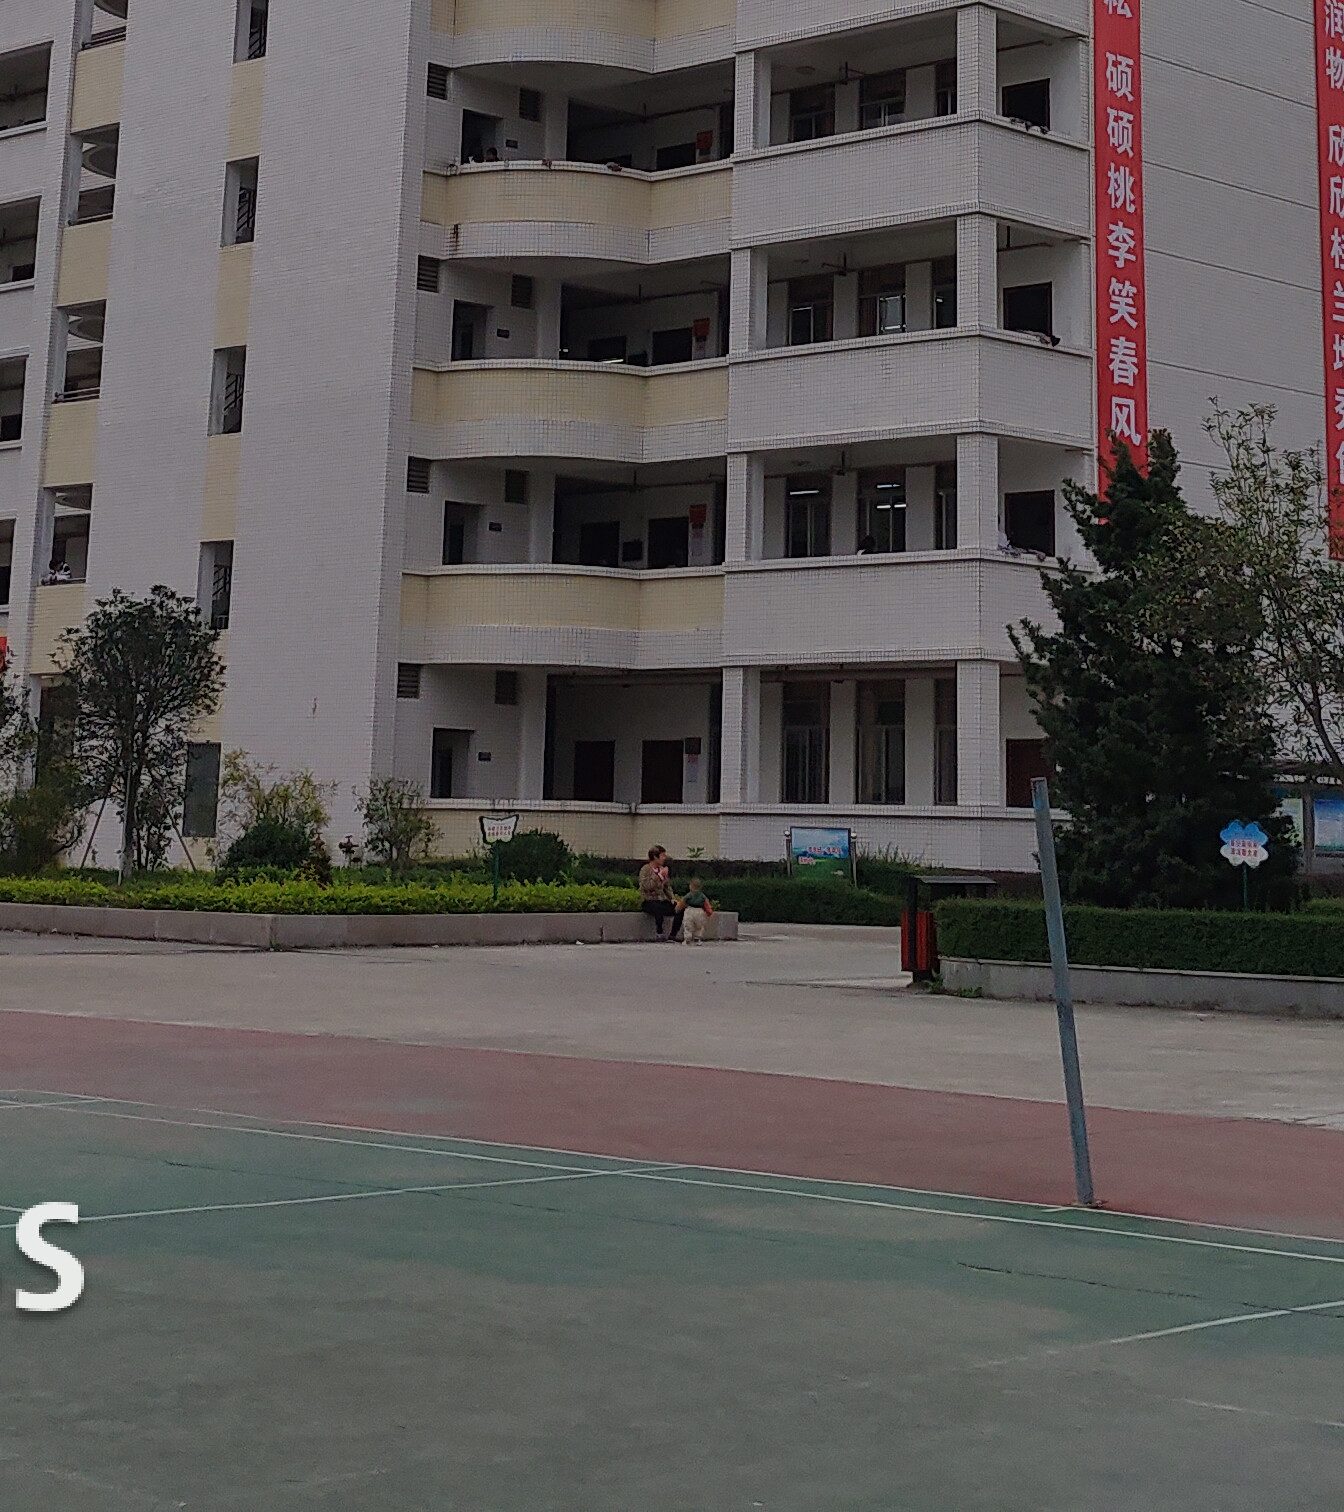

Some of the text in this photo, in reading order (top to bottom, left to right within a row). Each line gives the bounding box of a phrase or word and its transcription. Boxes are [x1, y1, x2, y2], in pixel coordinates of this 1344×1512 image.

[1106, 51, 1142, 446] 硕硕桃李笑春风
